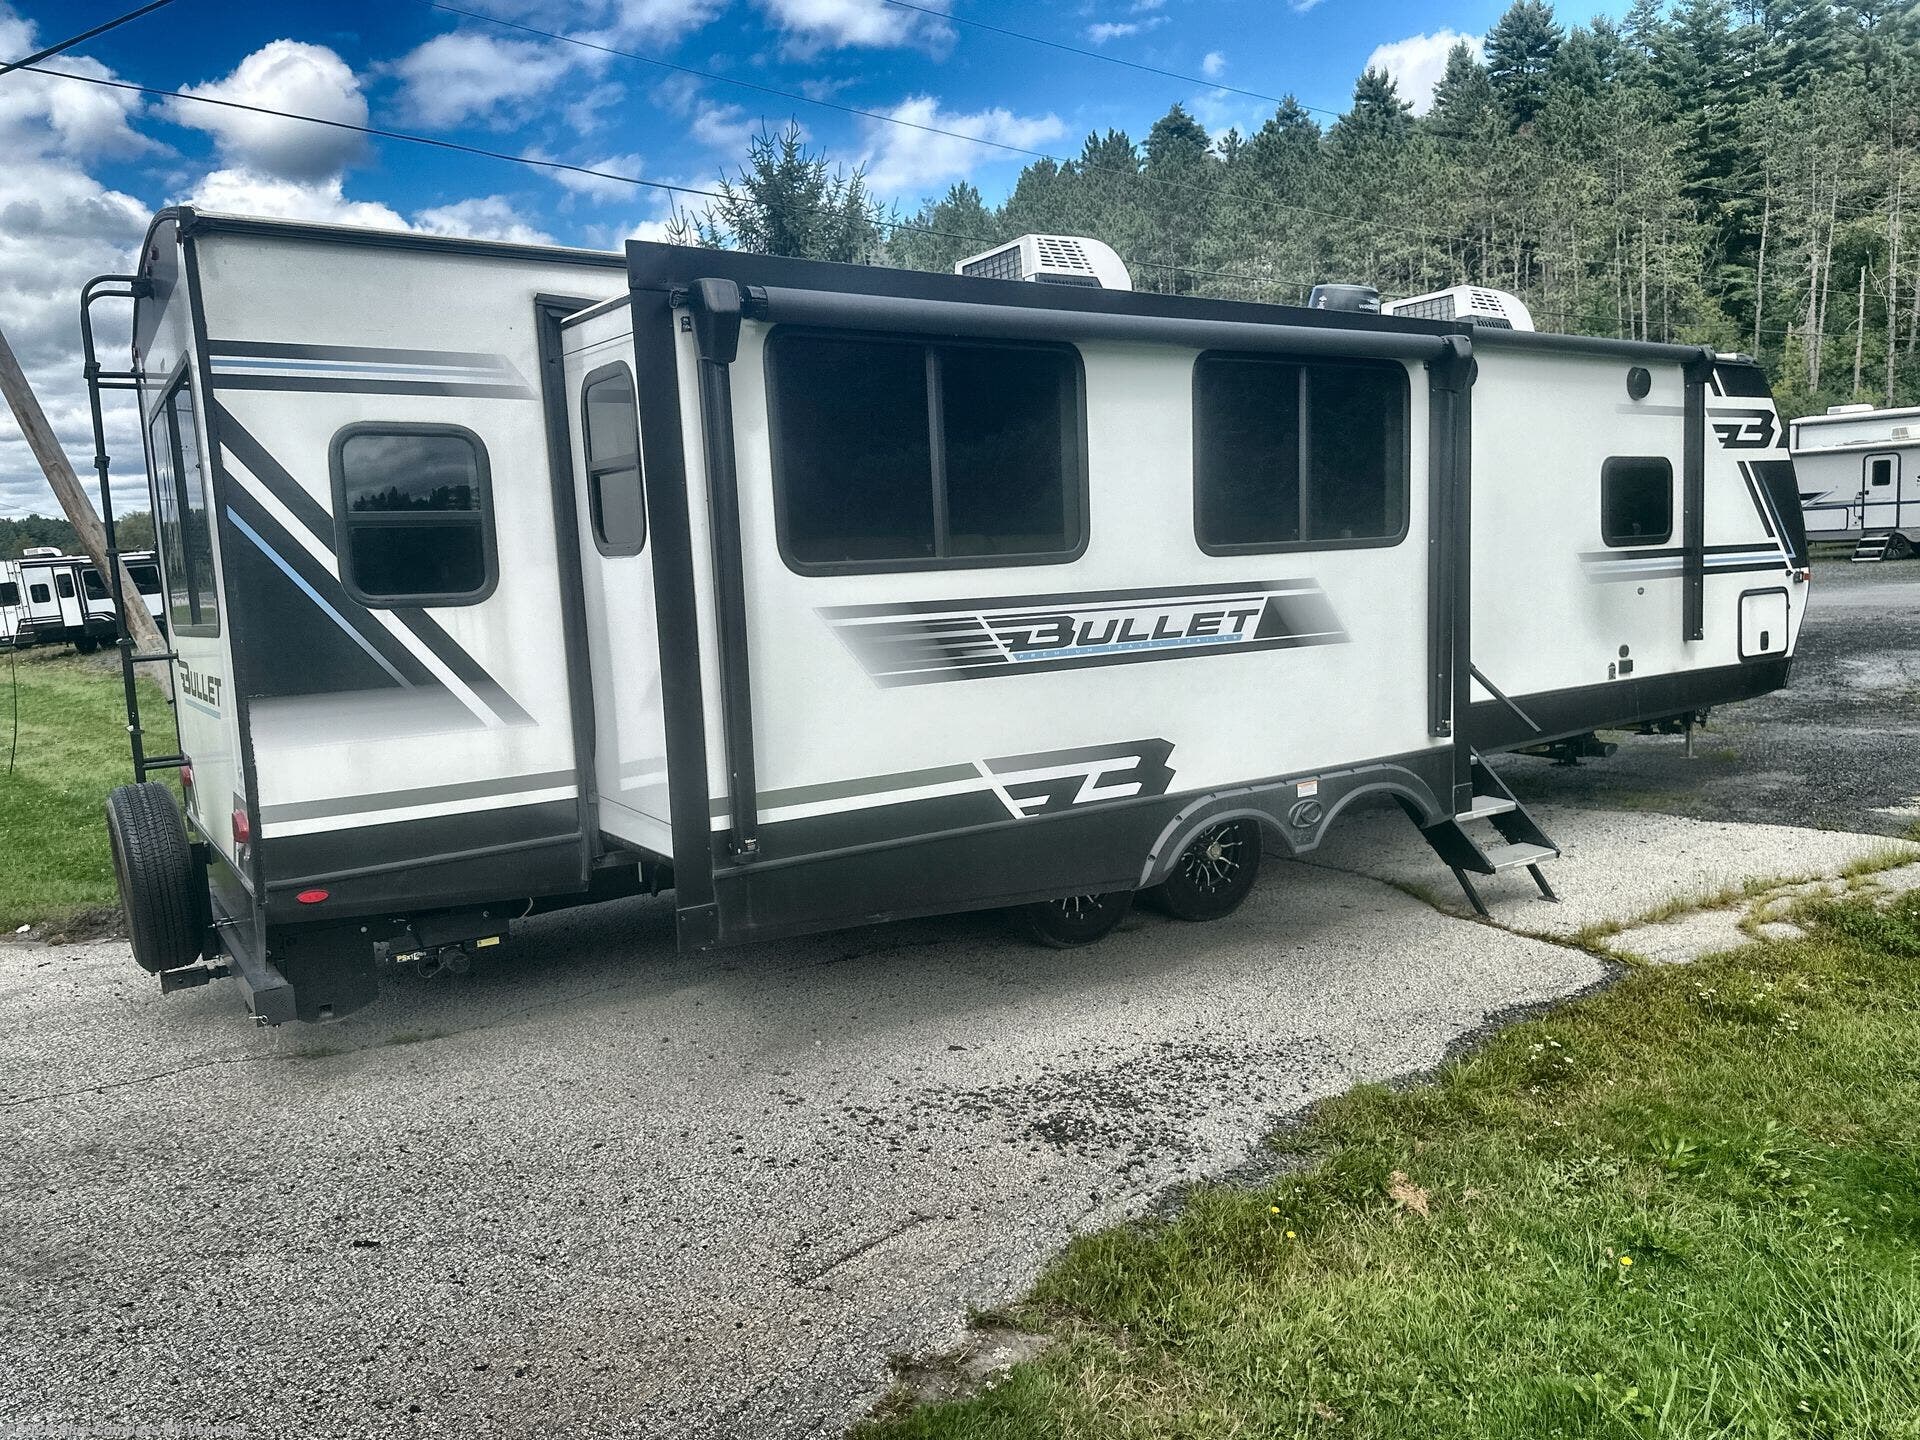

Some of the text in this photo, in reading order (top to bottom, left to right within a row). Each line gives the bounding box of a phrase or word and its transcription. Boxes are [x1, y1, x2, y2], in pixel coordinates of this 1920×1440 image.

[985, 608, 1260, 652] BULLET
[1018, 635, 1239, 660] PREMIUM TRAVEL TRAILER
[177, 660, 221, 707] BULLET
